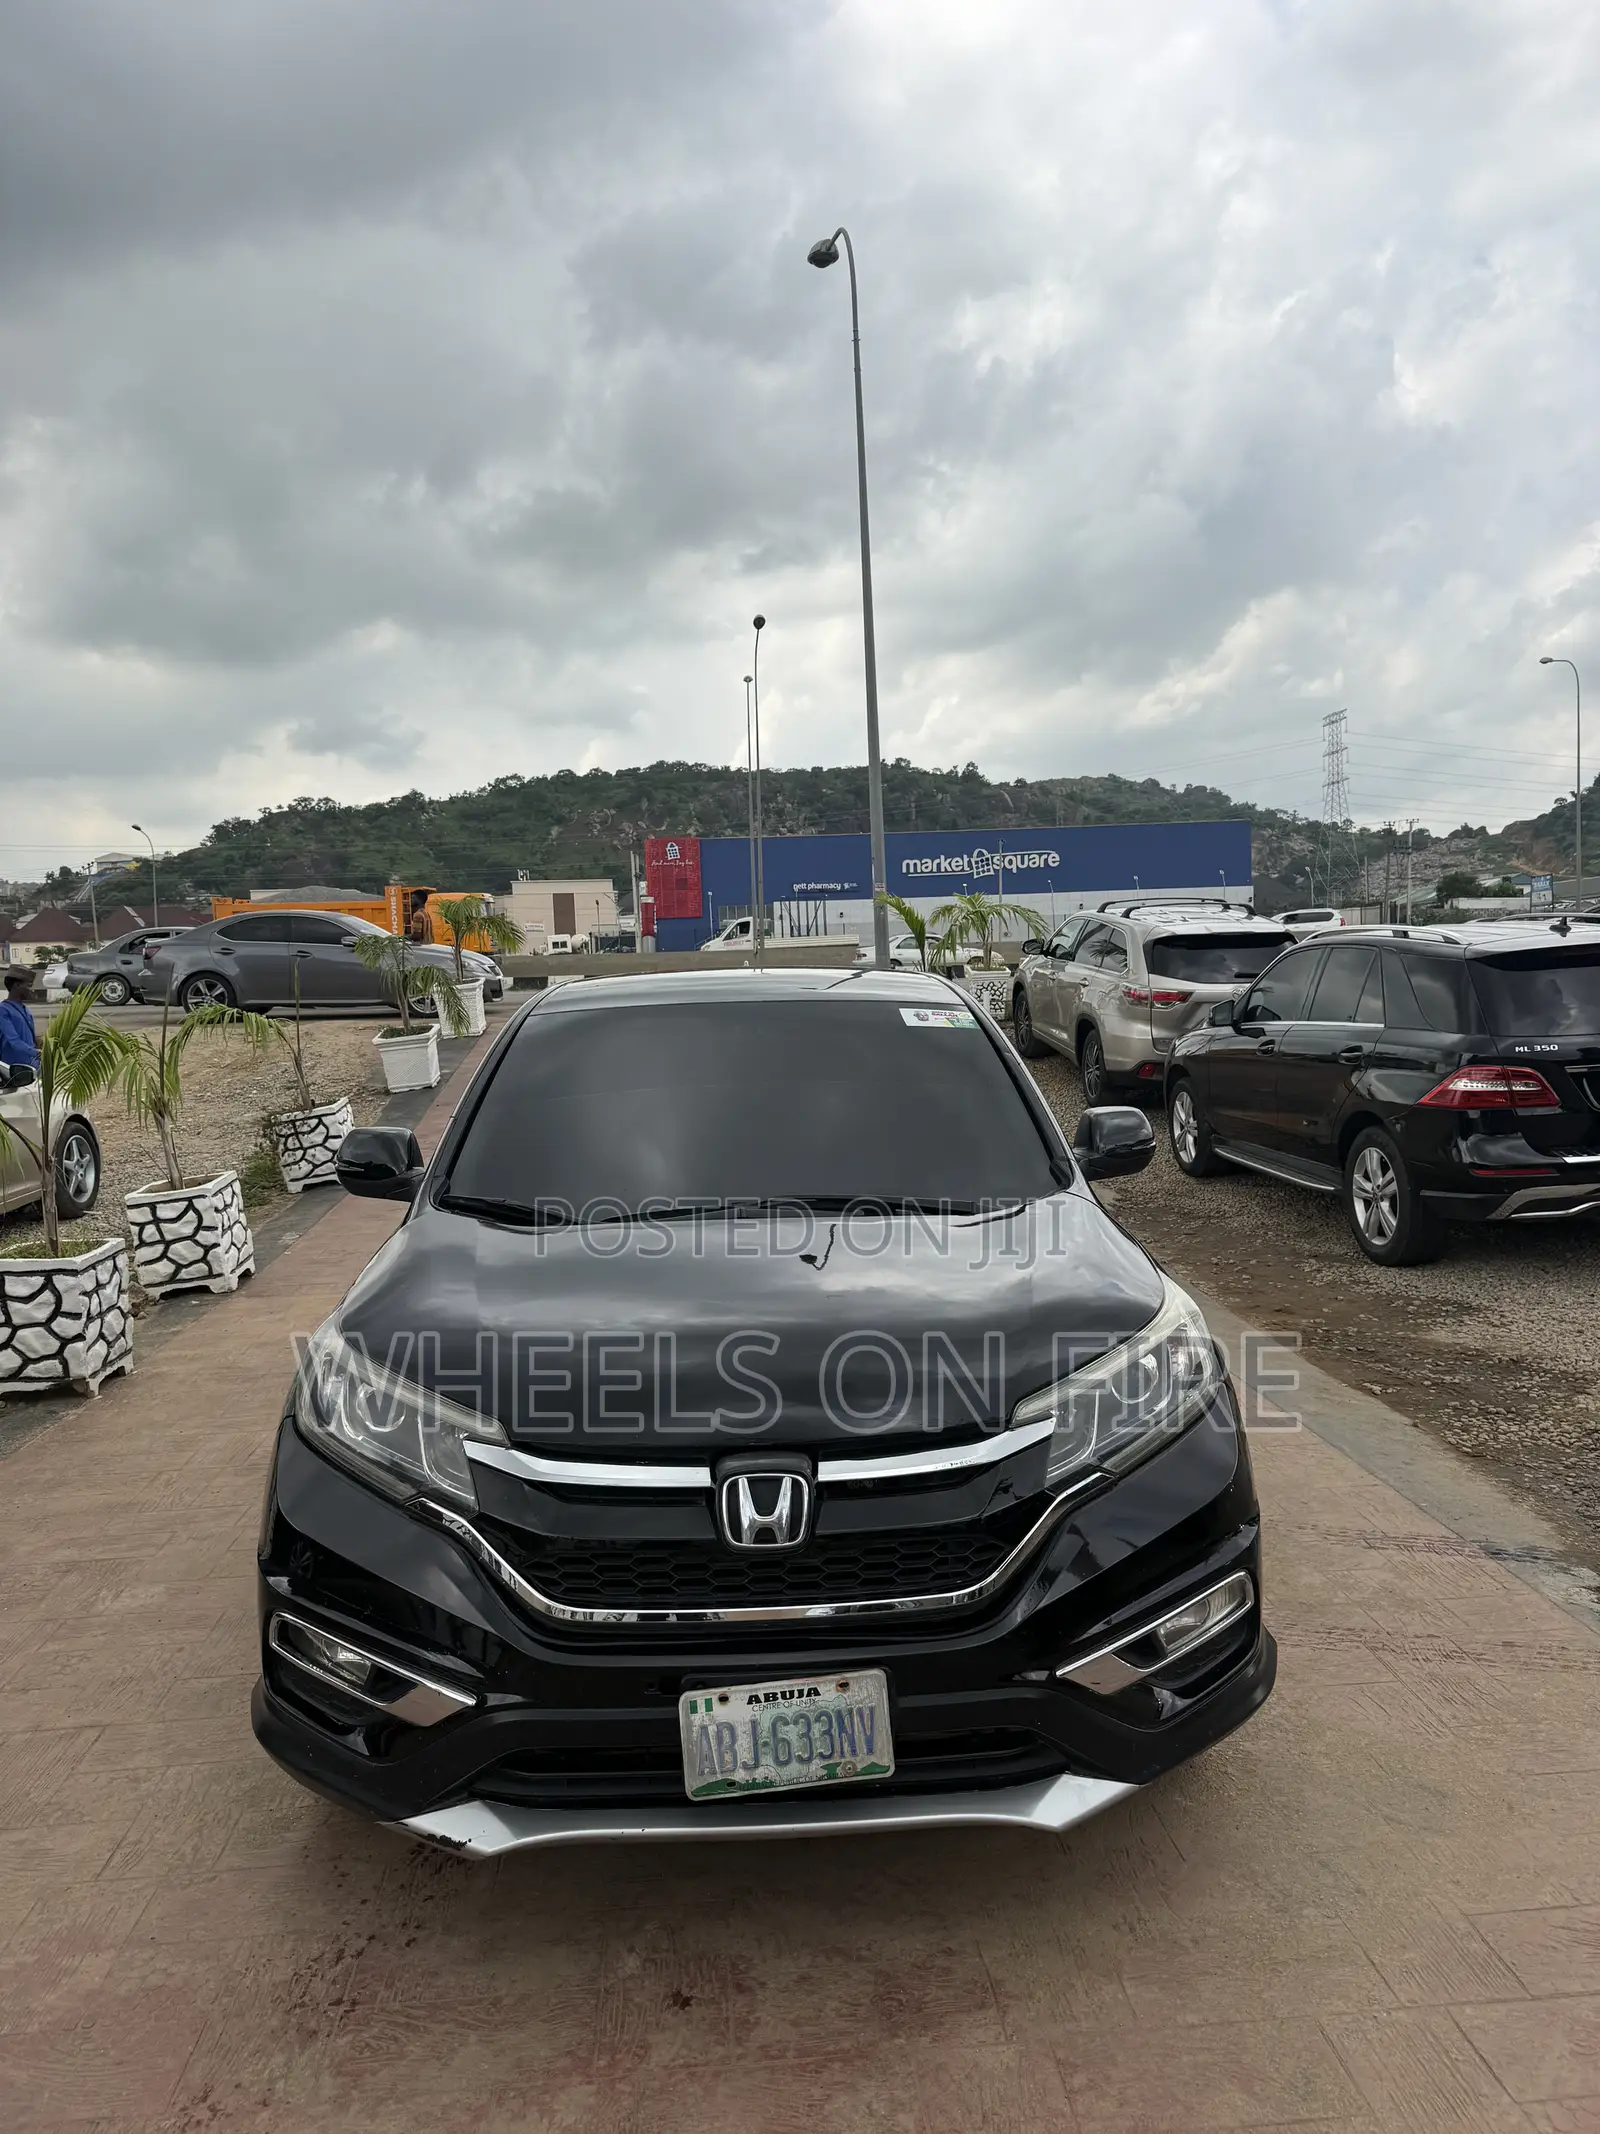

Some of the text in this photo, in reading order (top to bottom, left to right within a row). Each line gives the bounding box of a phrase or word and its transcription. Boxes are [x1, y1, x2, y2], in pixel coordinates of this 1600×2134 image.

[902, 852, 1061, 874] market square
[793, 882, 807, 892] gett
[807, 882, 841, 891] pharmacy
[390, 896, 398, 936] SHACMA
[1533, 1044, 1559, 1052] 350
[746, 1687, 822, 1706] ABUJA
[752, 1697, 817, 1713] CENTRE OF UNITY
